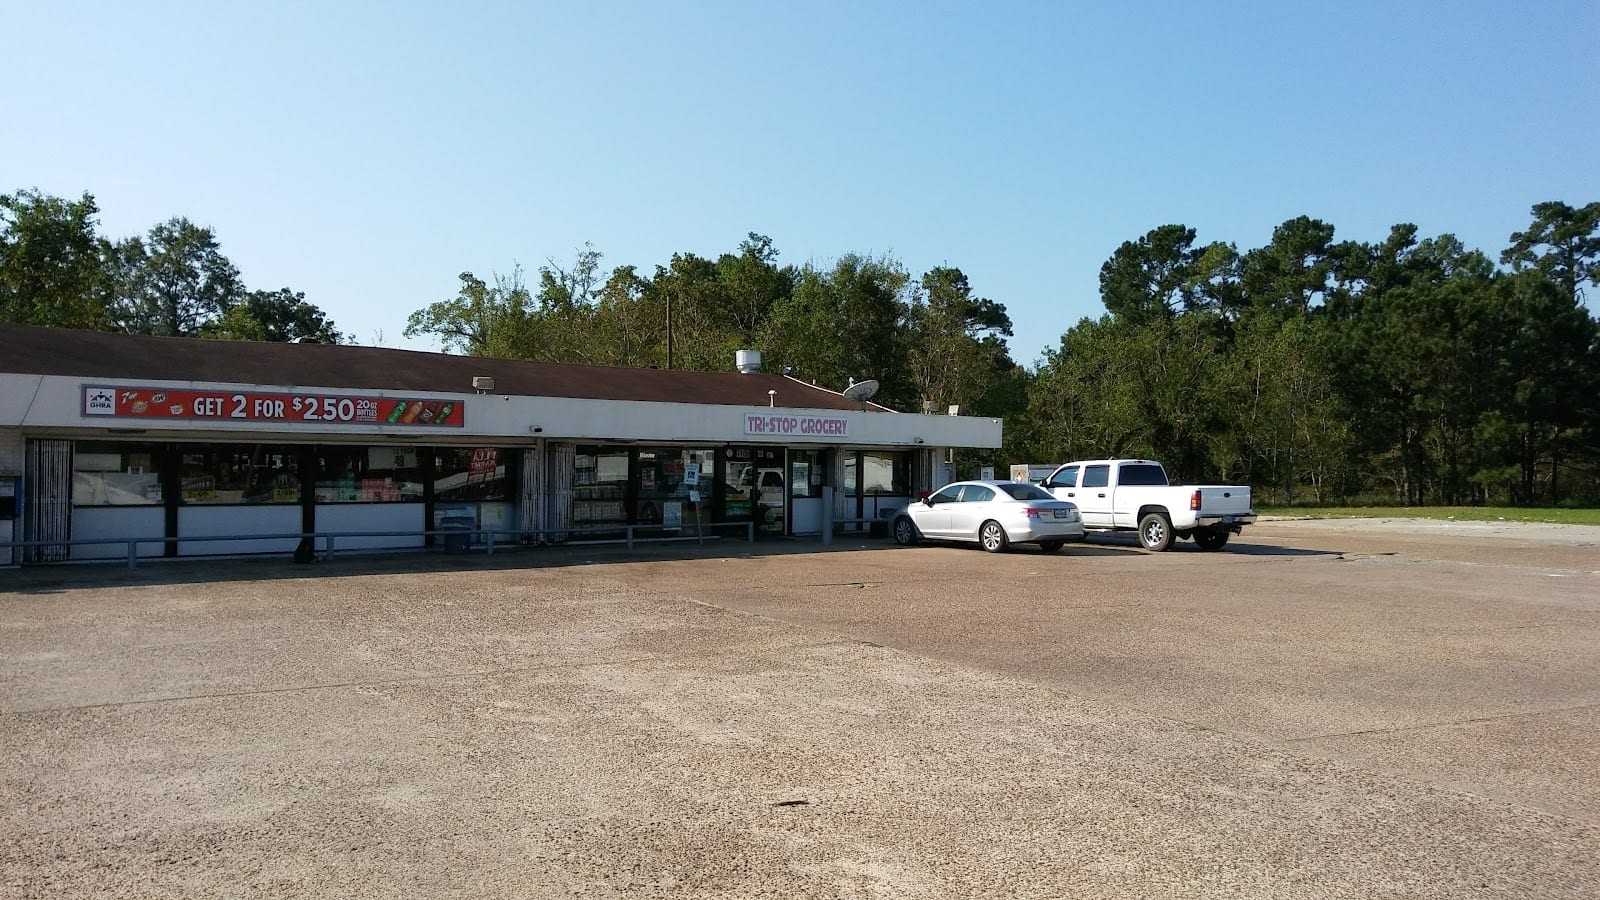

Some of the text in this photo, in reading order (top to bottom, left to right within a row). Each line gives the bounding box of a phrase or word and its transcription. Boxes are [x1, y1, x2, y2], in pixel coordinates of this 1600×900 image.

[193, 397, 224, 416] GET
[231, 394, 247, 417] 2
[254, 399, 285, 418] FOR
[292, 397, 355, 421] $2.50
[357, 400, 370, 409] 20
[357, 408, 378, 417] BOTTLES
[800, 418, 848, 435] GROCERY
